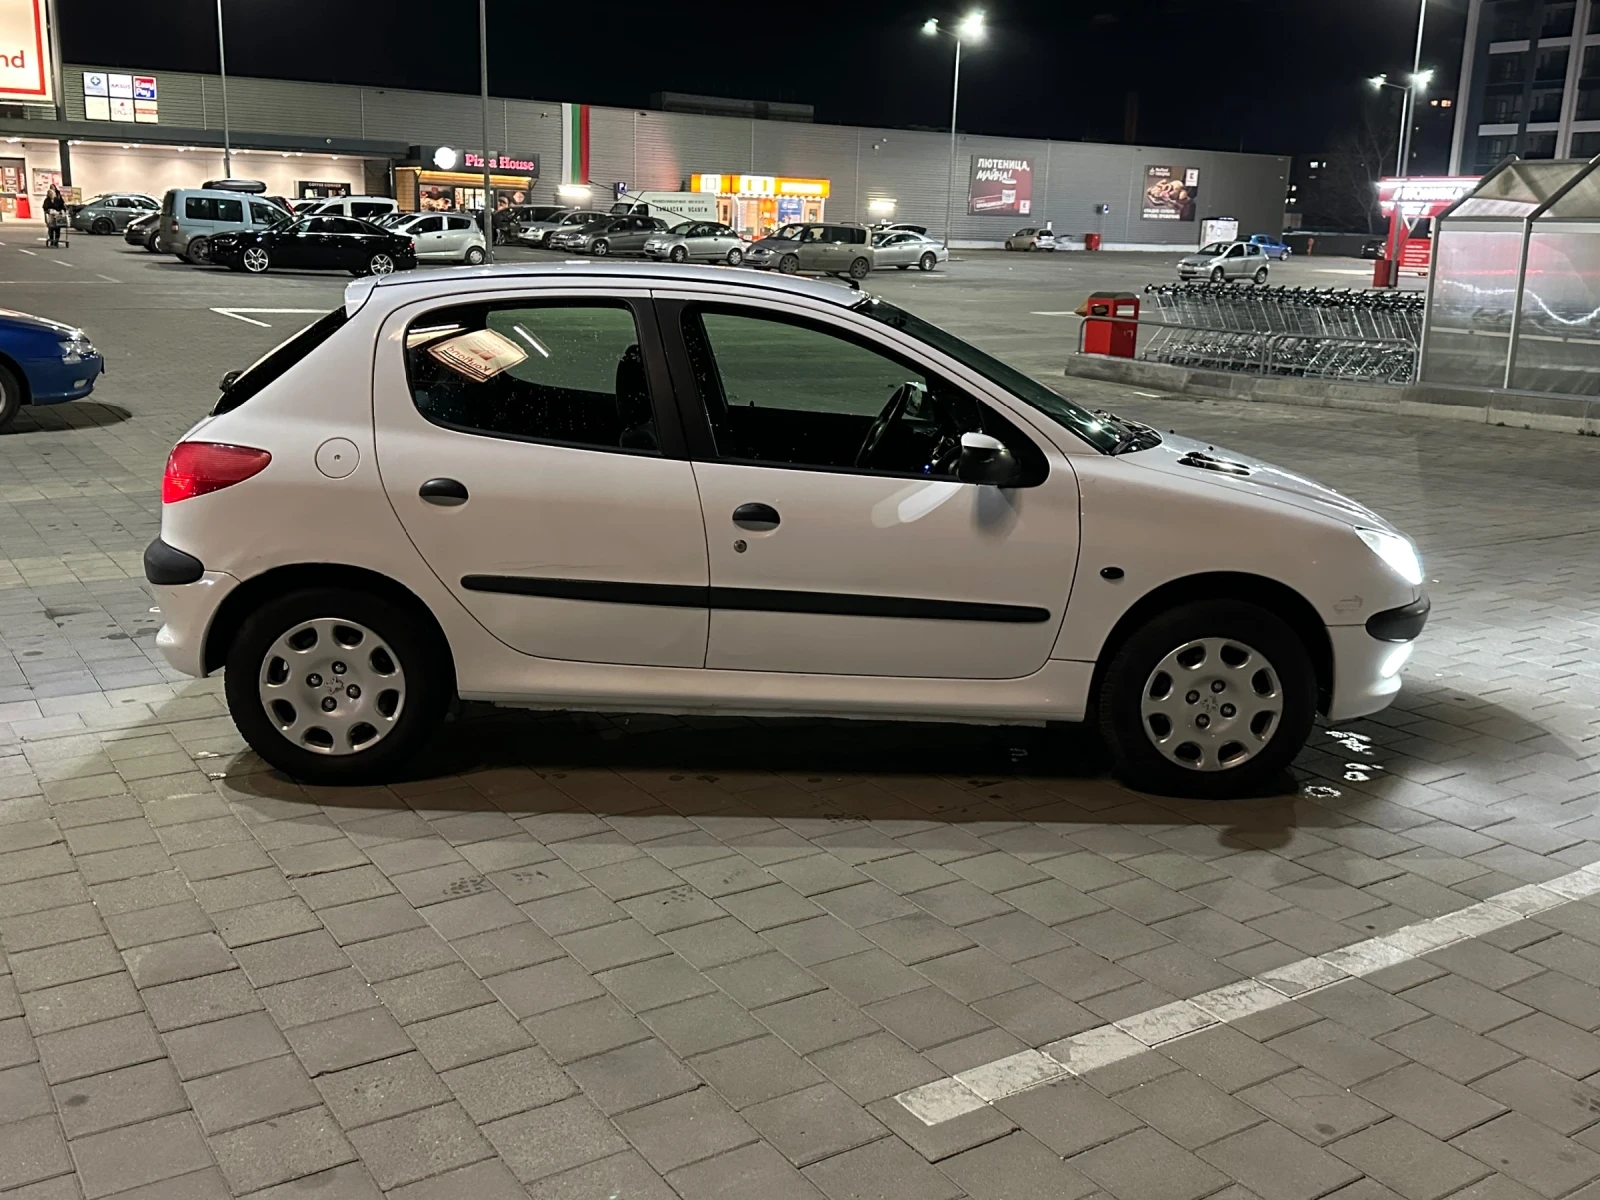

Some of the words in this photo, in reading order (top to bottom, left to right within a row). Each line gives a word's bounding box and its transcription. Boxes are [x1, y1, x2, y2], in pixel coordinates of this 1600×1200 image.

[136, 80, 154, 91] Easy
[136, 88, 151, 98] Pay
[465, 154, 498, 168] Piza
[499, 156, 534, 170] House
[978, 158, 1030, 172] ЛЮТЕНИЦА,
[976, 168, 1012, 182] МАЙНА!
